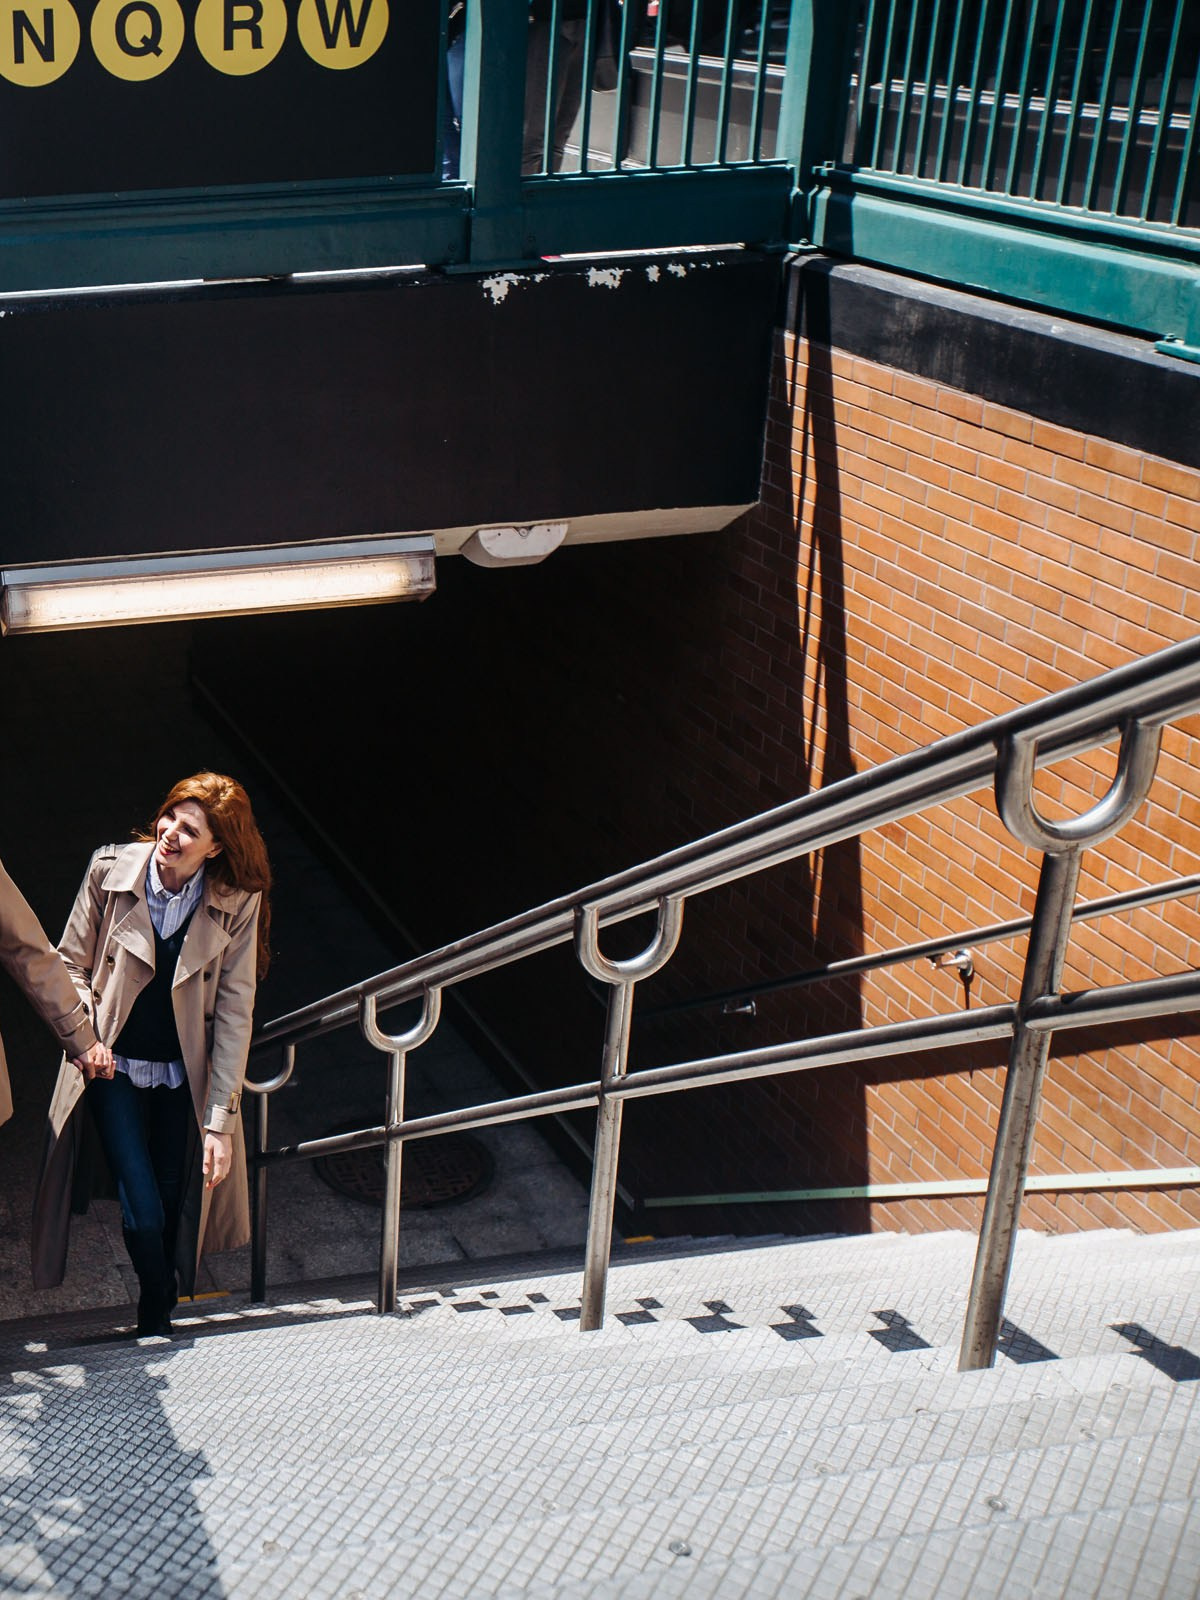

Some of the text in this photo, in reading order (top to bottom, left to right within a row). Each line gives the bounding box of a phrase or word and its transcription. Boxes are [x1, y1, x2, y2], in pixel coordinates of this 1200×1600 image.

[13, 0, 374, 64] N Q R W
